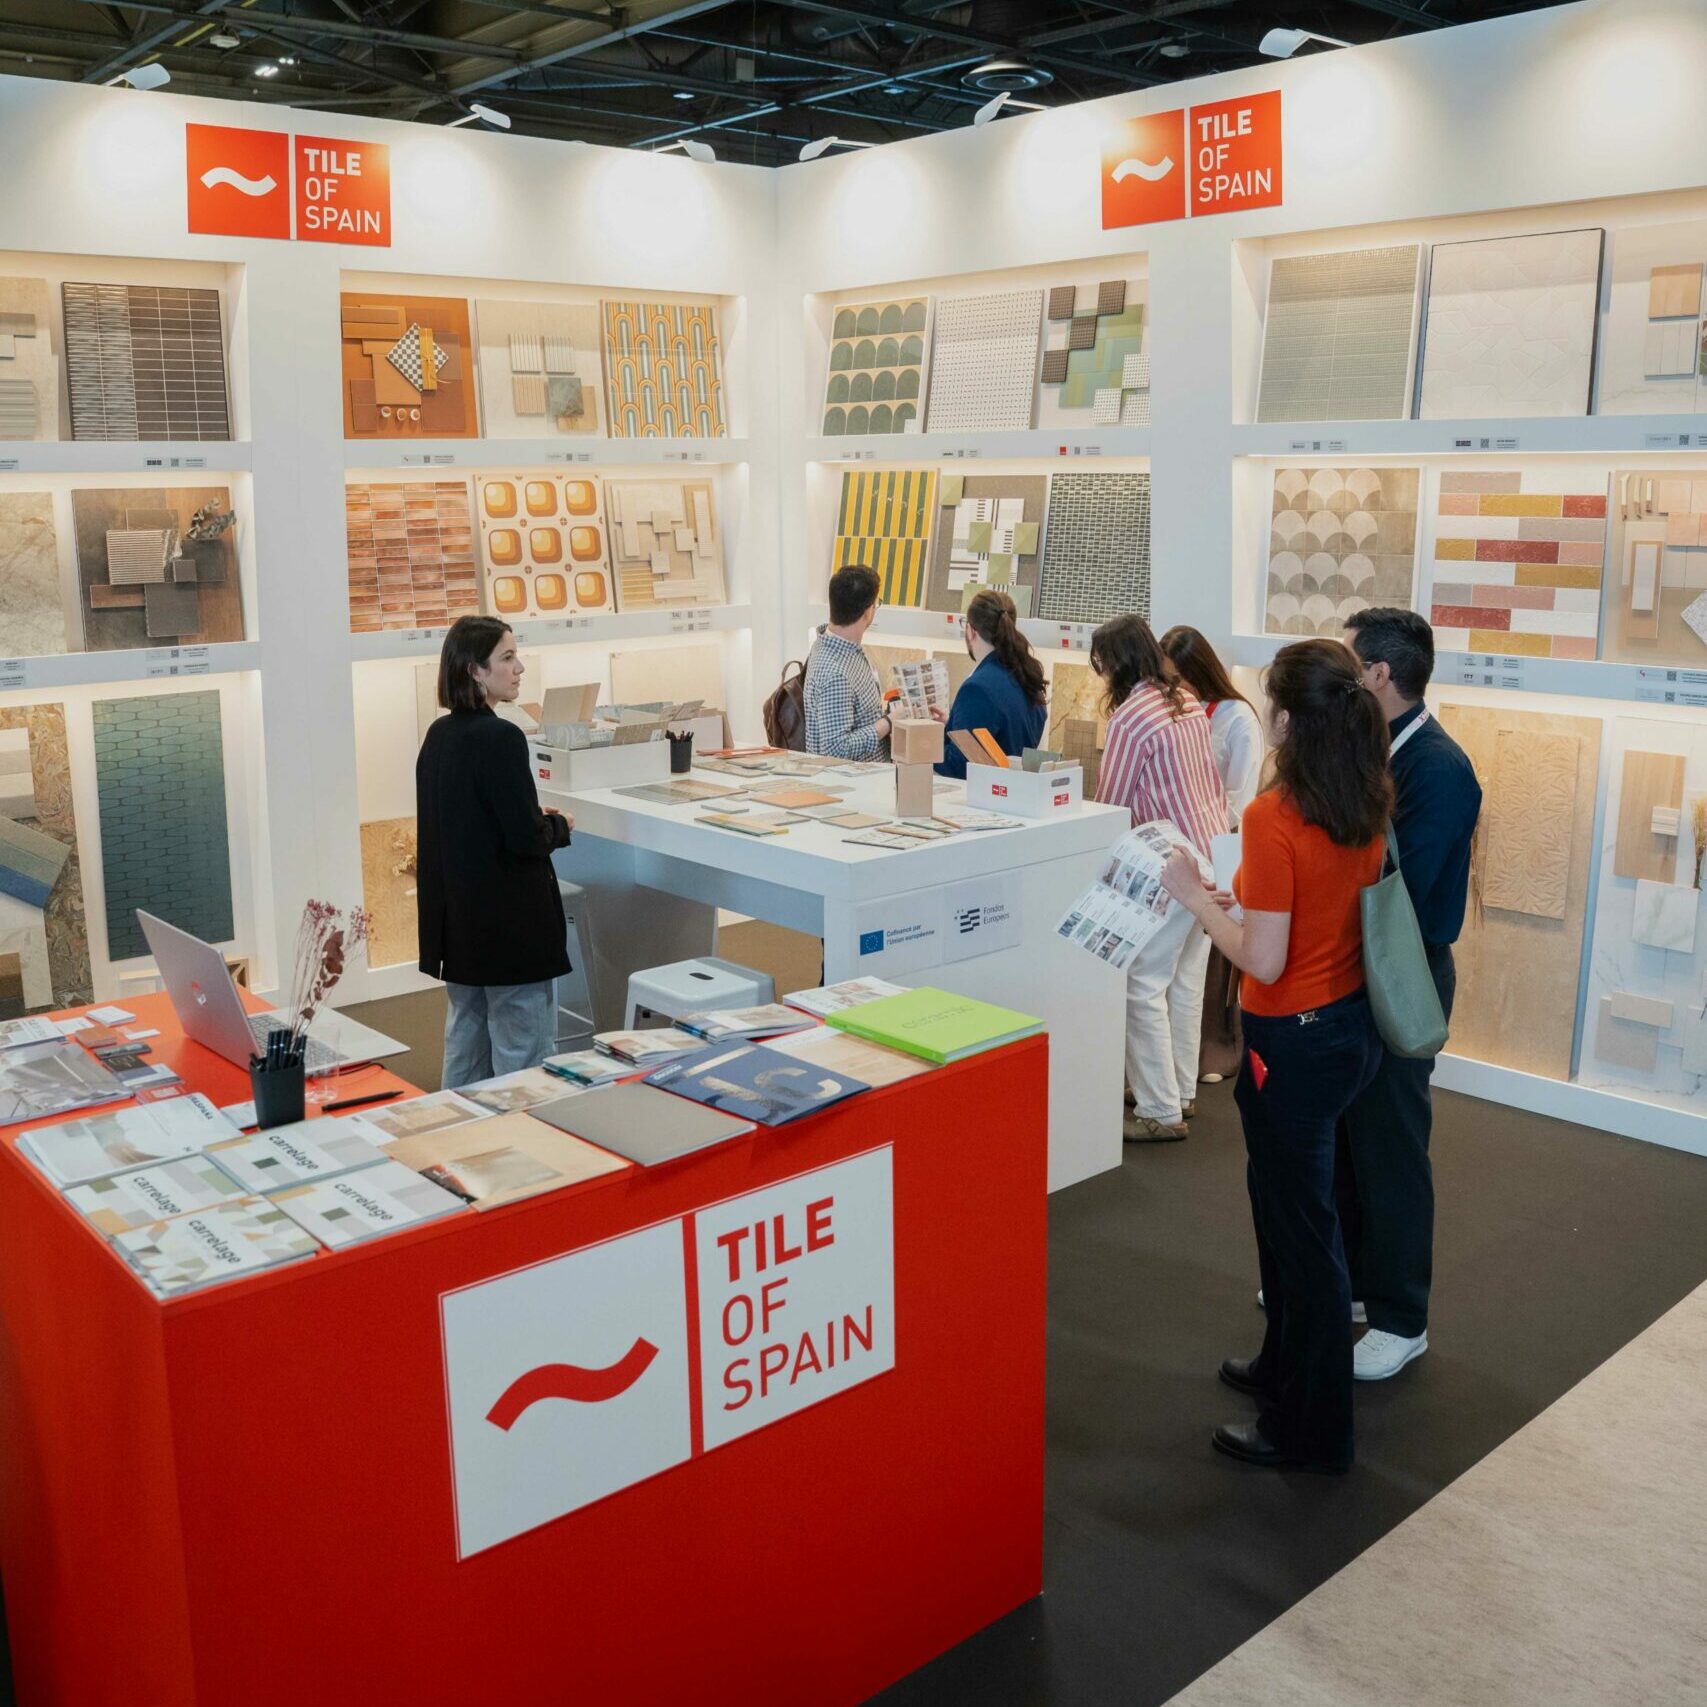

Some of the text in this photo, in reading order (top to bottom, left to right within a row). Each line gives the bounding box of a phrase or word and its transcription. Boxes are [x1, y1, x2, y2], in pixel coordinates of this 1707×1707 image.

[1197, 108, 1252, 142] TILE
[303, 148, 362, 176] TILE
[1199, 143, 1230, 172] OF
[305, 177, 338, 201] OF
[1199, 167, 1271, 202] SPAIN
[305, 205, 381, 234] SPAIN
[983, 904, 1004, 915] Fondos
[269, 1134, 319, 1171] carrelage
[133, 1175, 182, 1215] carrelage
[334, 1182, 393, 1222] carrelage
[188, 1218, 241, 1264] carrelage
[716, 1195, 835, 1283] TILE
[721, 1276, 789, 1347] OF
[722, 1304, 873, 1412] SPAIN
